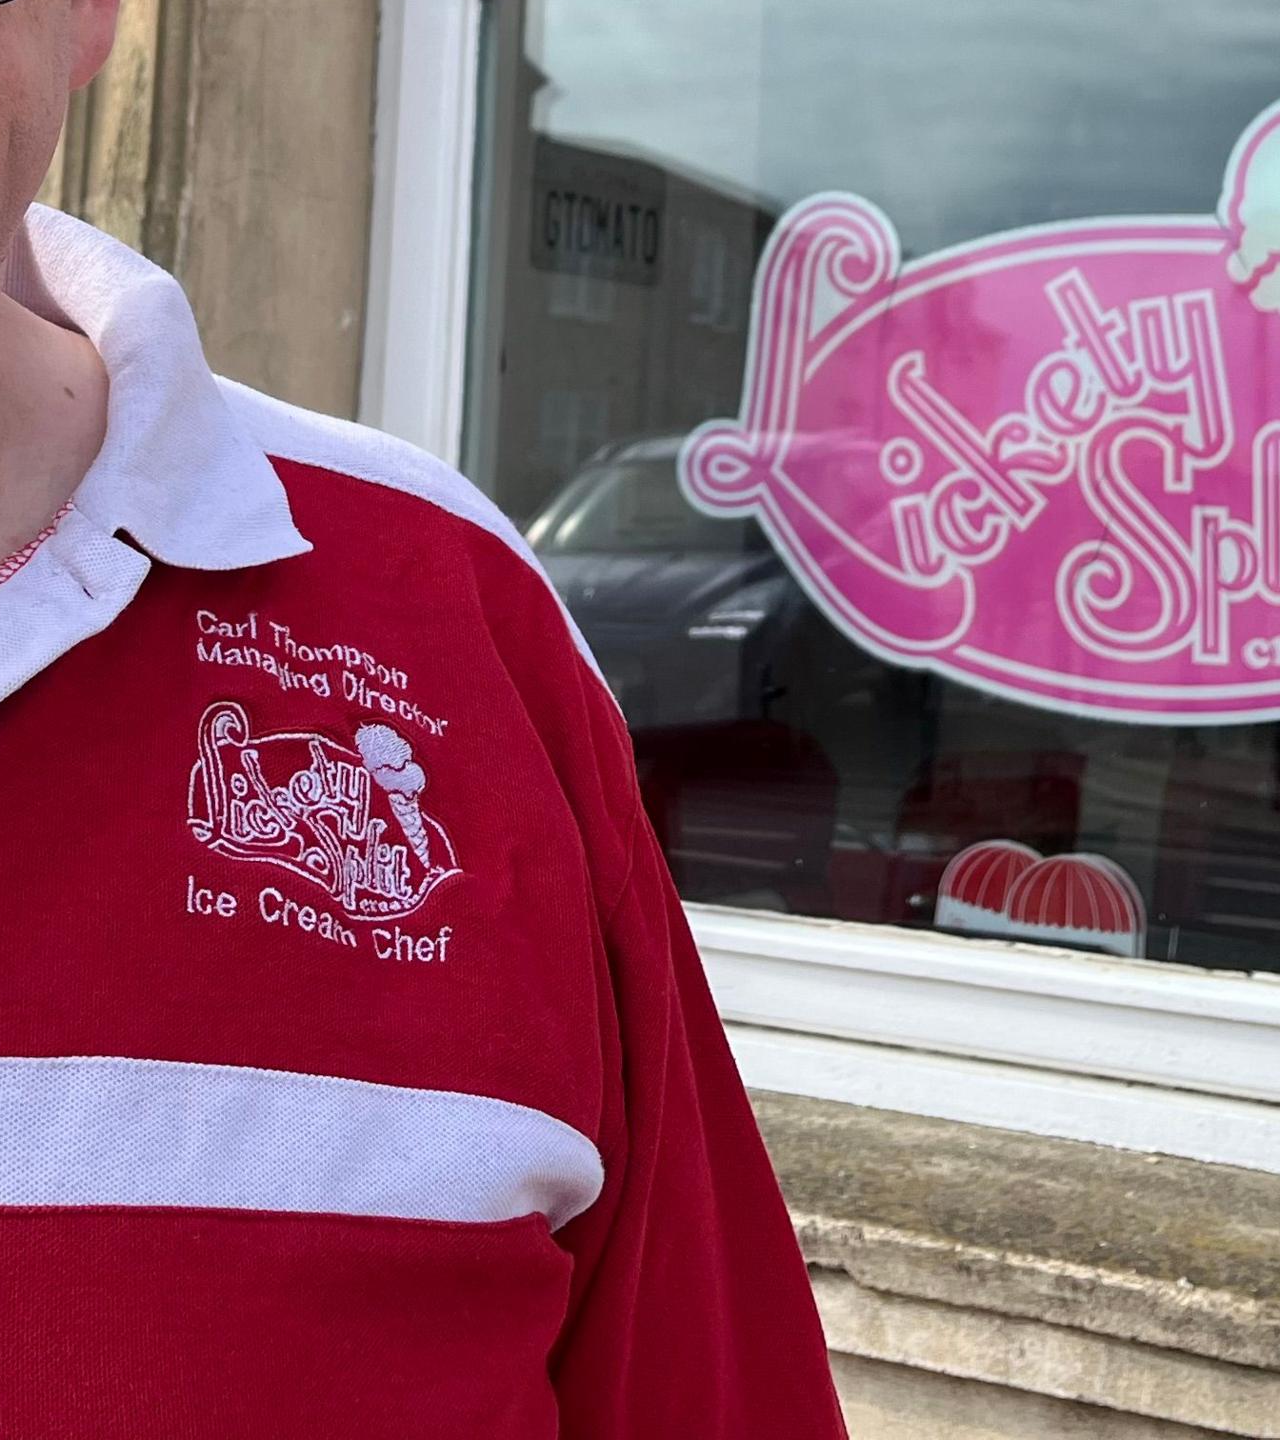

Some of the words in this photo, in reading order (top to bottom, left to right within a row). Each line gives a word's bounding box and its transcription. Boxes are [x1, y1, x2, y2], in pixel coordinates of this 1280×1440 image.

[677, 189, 1235, 665] Lickety
[196, 610, 258, 640] Carl
[269, 621, 409, 691] Thompson
[187, 702, 371, 860] Lickety
[303, 806, 414, 910] Split
[186, 875, 238, 918] Ice
[259, 887, 358, 948] Cream
[371, 926, 453, 962] Chef
